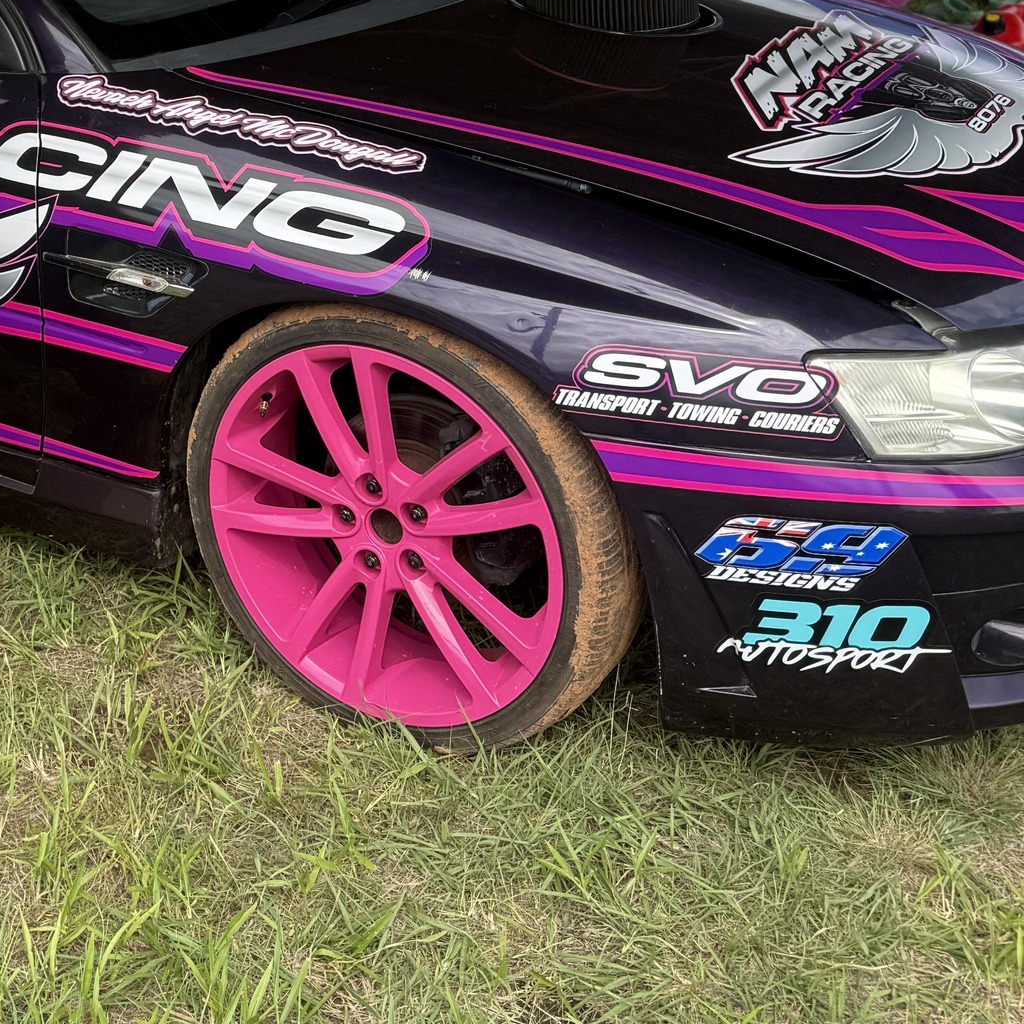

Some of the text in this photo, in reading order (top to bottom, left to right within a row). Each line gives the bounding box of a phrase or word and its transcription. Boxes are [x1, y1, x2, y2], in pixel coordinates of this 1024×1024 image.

[743, 14, 873, 121] NAM
[798, 36, 914, 119] RACING
[63, 79, 154, 109] Nevaeh
[152, 100, 243, 126] Angel
[967, 93, 1013, 132] 8076
[583, 352, 827, 405] SVO
[554, 388, 841, 435] TRANSPORT TOWING COURIERS
[694, 516, 909, 577] 69
[704, 564, 862, 592] DESIGNS
[742, 598, 932, 650] 310
[717, 637, 953, 674] AUTOSPORT
